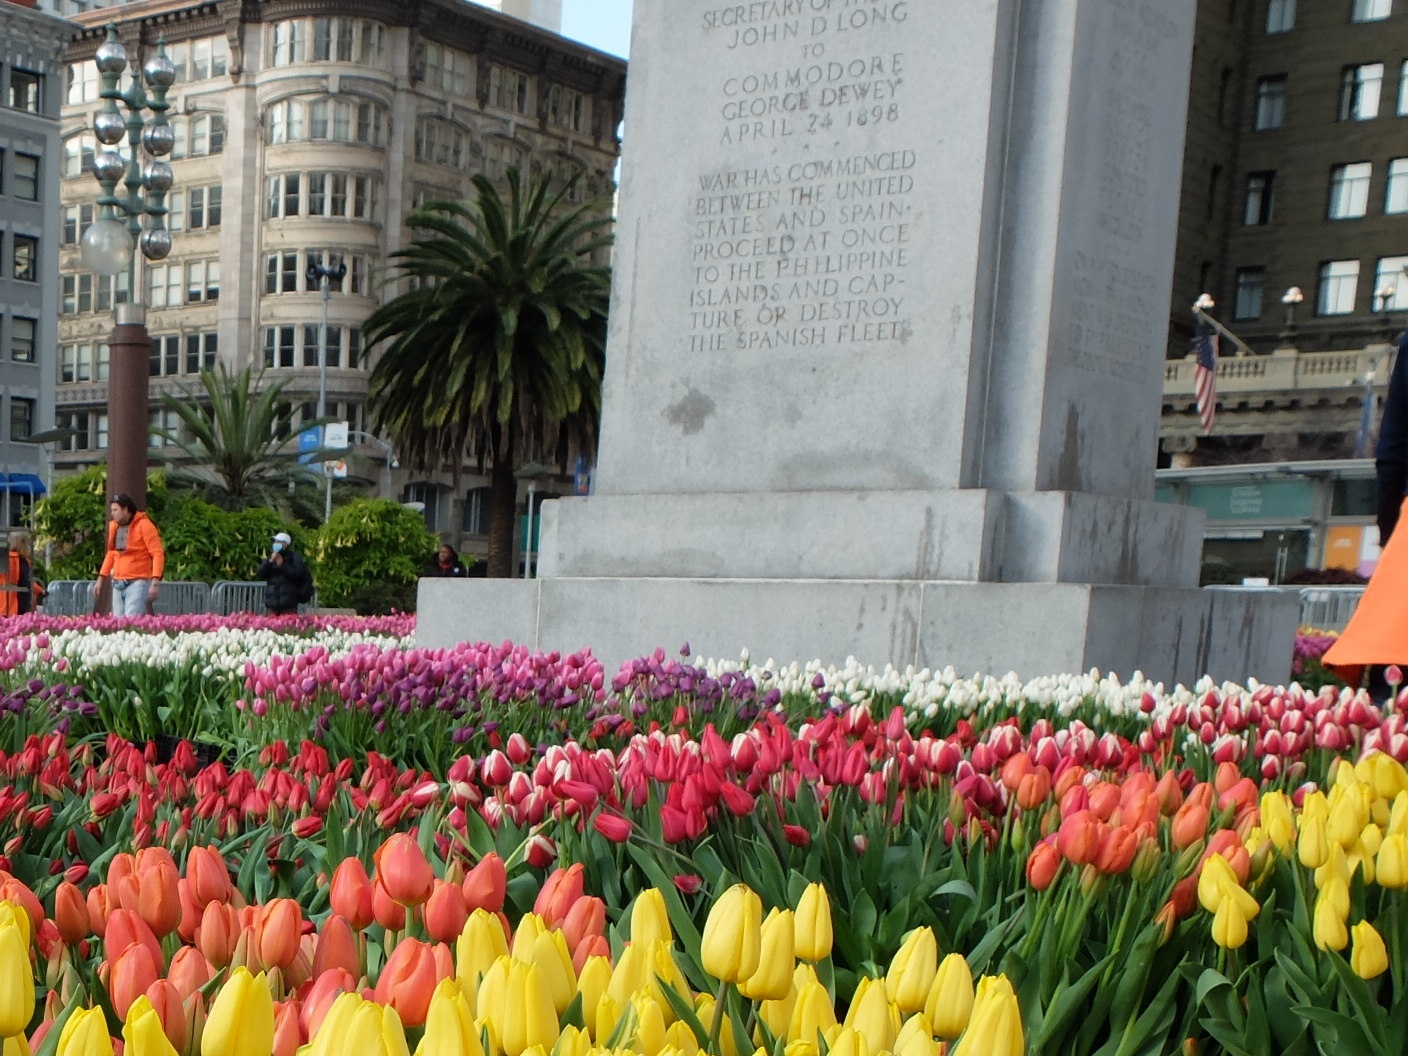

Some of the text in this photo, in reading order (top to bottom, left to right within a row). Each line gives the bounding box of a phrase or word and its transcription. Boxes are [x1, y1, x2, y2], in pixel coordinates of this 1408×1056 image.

[702, 0, 804, 30] SECRETARY
[728, 2, 908, 49] JOHN D LONG
[801, 42, 825, 59] TO
[723, 52, 904, 97] COMMODORE
[722, 78, 902, 121] GEORGE DEWEY
[720, 103, 899, 144] APRIL 24 1898
[698, 150, 916, 193] WAR HAS COMMENCED
[696, 175, 914, 216] BETWEEN THE UNITED
[694, 214, 765, 239] STATES
[776, 208, 826, 231] AND
[693, 223, 910, 262] PROCEED AT ONCE
[693, 248, 908, 284] TO THE PHILIPPINE
[690, 272, 905, 308] ISLANDS AND CAP-
[690, 297, 904, 330] TURE OR DESTROY
[689, 333, 727, 353] THE
[736, 326, 826, 350] SPANISH
